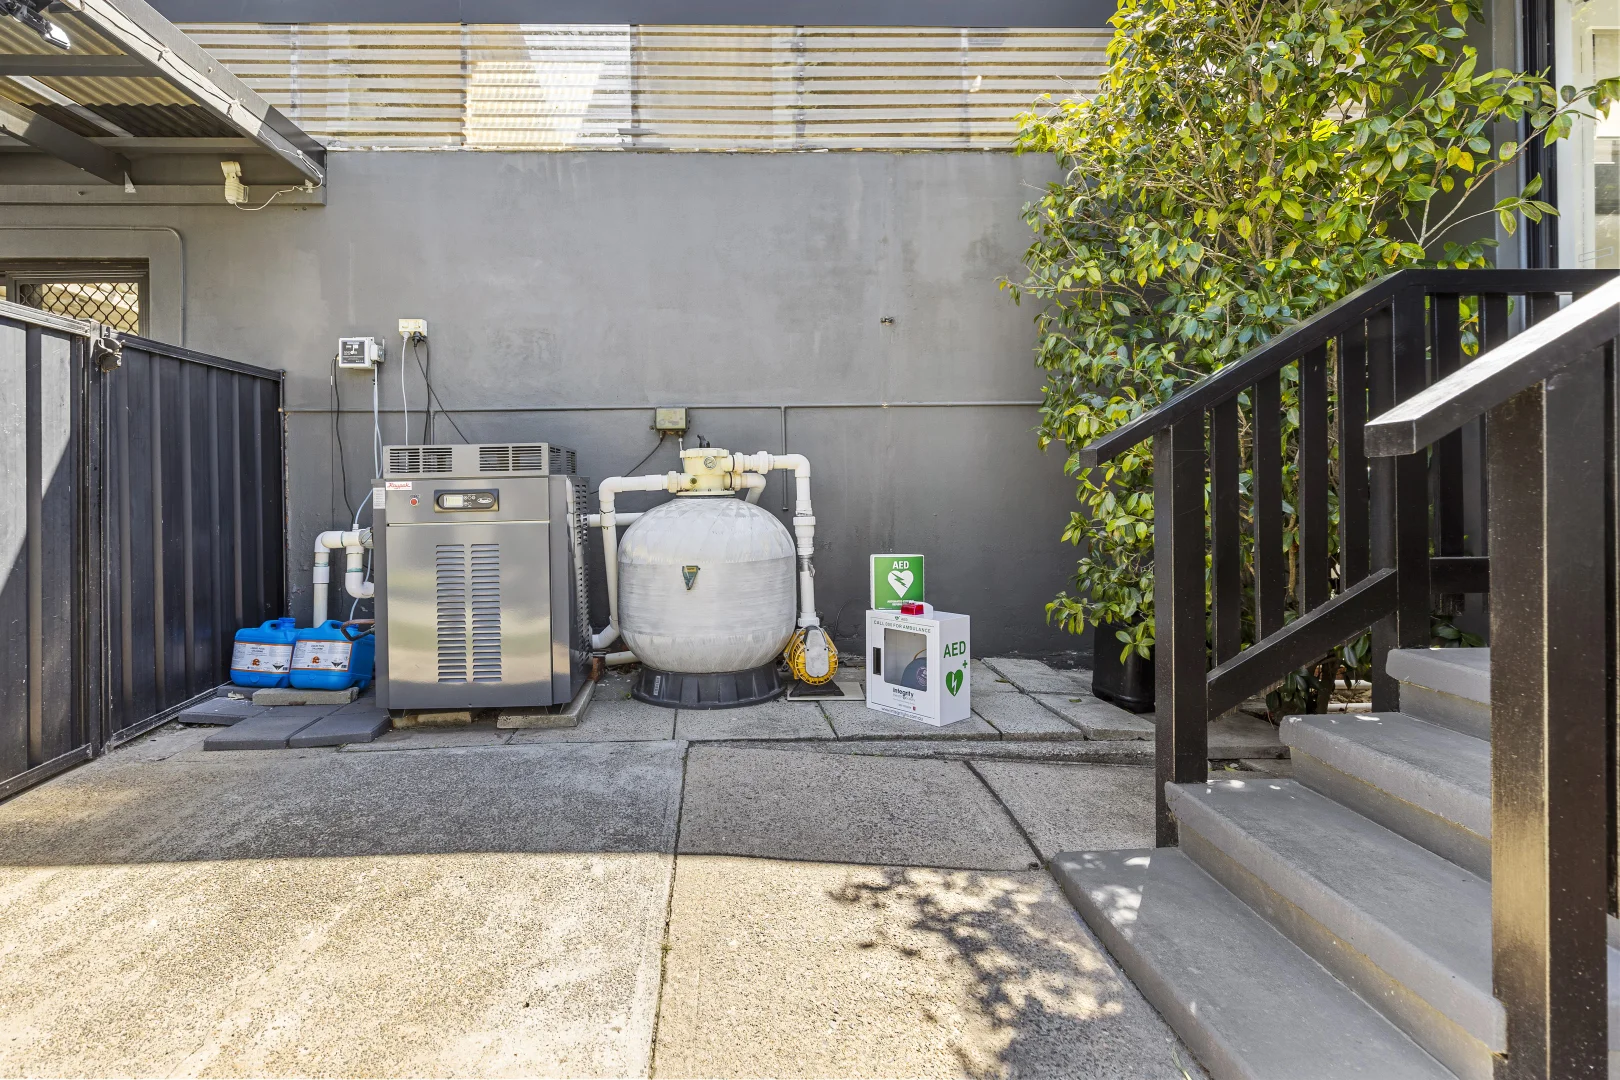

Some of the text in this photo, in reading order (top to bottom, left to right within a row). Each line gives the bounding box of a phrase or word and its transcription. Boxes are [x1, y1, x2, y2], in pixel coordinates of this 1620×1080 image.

[892, 560, 910, 569] AED
[902, 624, 931, 633] AMBULANCE
[943, 640, 966, 659] AED
[892, 687, 915, 698] Integrity
